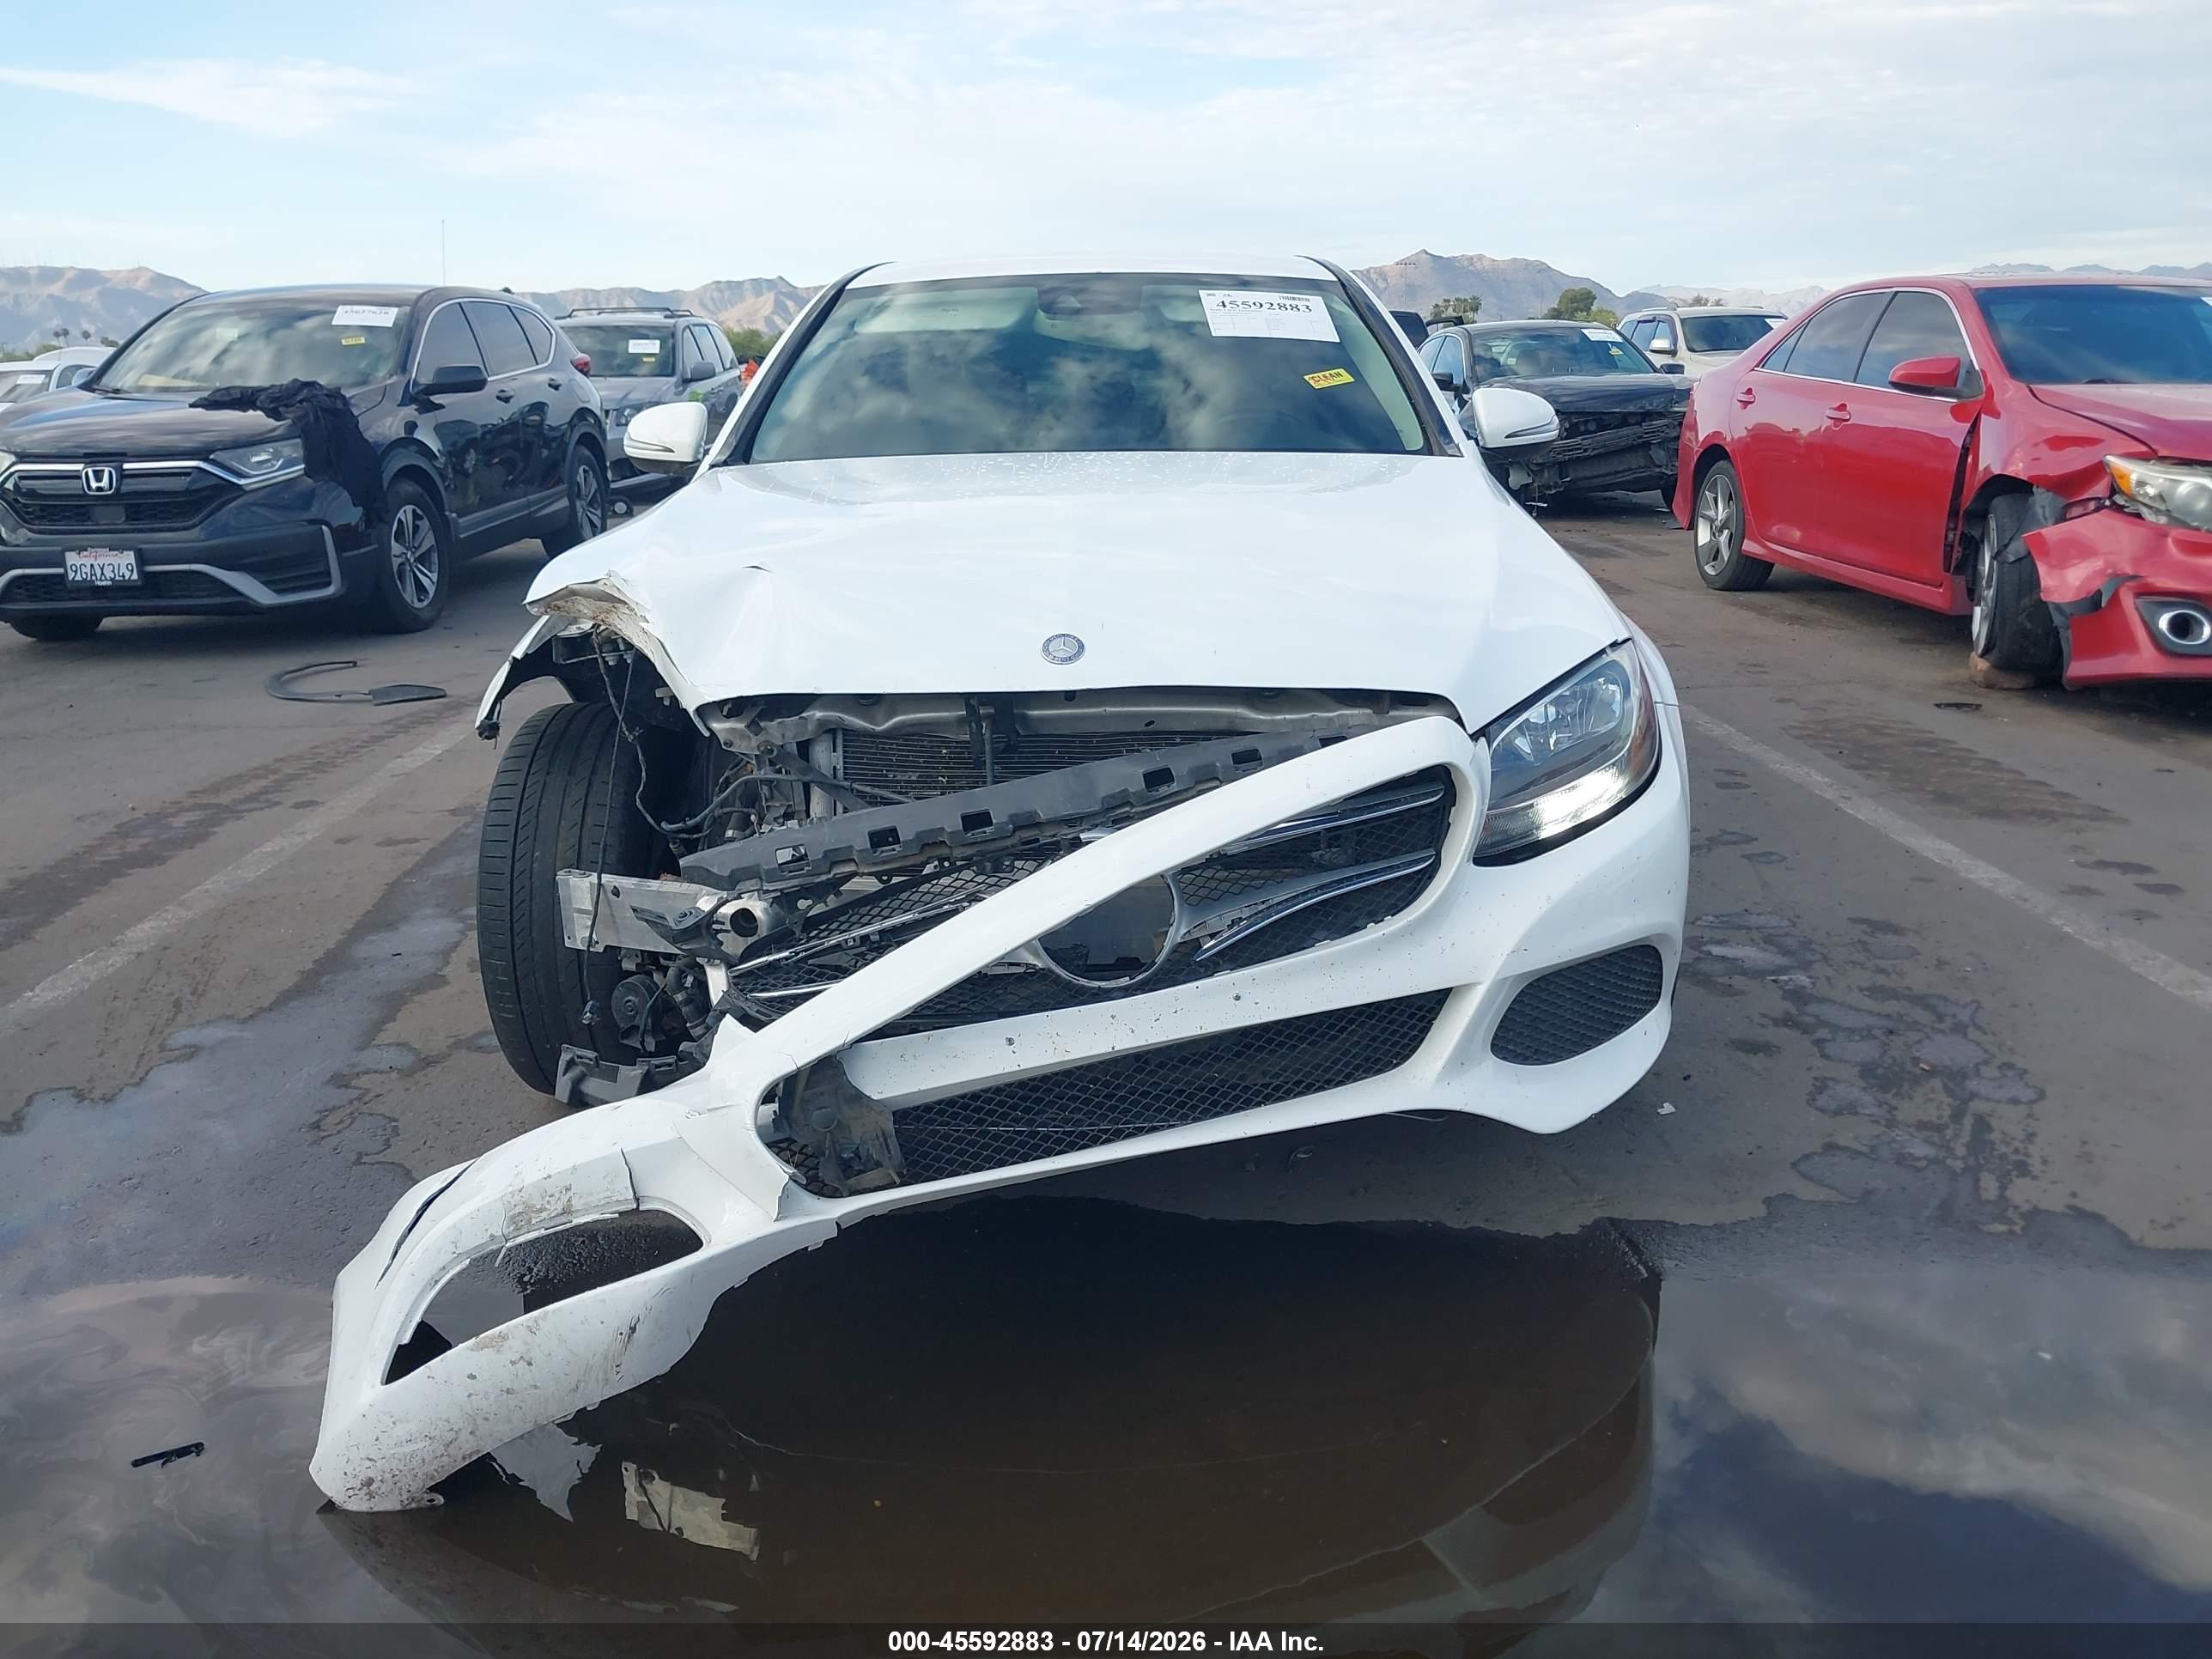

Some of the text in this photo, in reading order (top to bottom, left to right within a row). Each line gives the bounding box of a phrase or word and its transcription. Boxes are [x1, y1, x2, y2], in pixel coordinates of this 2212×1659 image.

[1216, 300, 1313, 313] 45592883
[1311, 371, 1344, 383] CLEAN
[70, 562, 135, 581] 9GAX349
